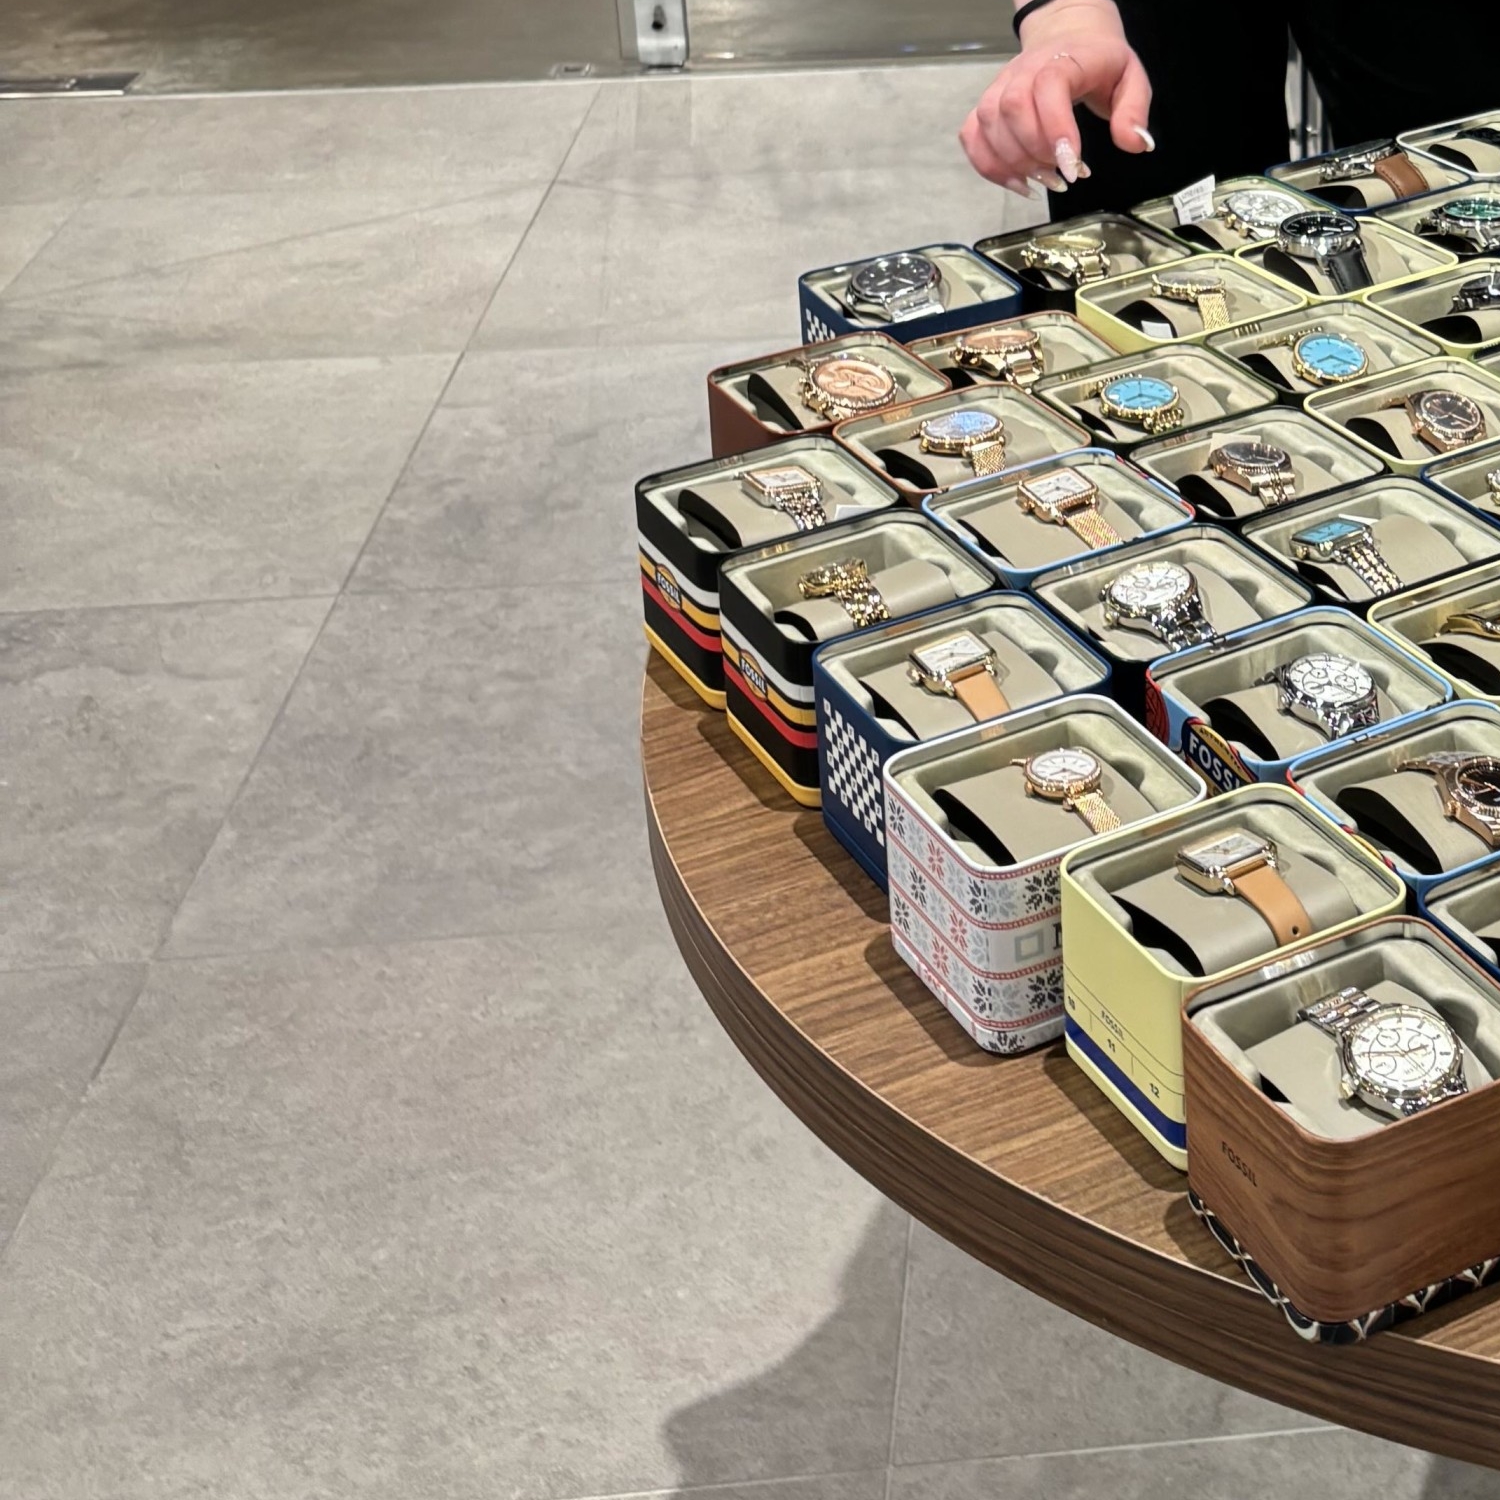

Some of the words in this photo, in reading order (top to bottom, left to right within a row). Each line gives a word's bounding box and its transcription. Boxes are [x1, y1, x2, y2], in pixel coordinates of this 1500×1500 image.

[656, 573, 681, 604] FOSSIL
[740, 658, 767, 694] FOSSIL
[1101, 1010, 1125, 1041] FOSSIL
[1107, 1038, 1116, 1053] 11
[1149, 1082, 1160, 1099] 12
[1221, 1140, 1258, 1188] FOSSIL
